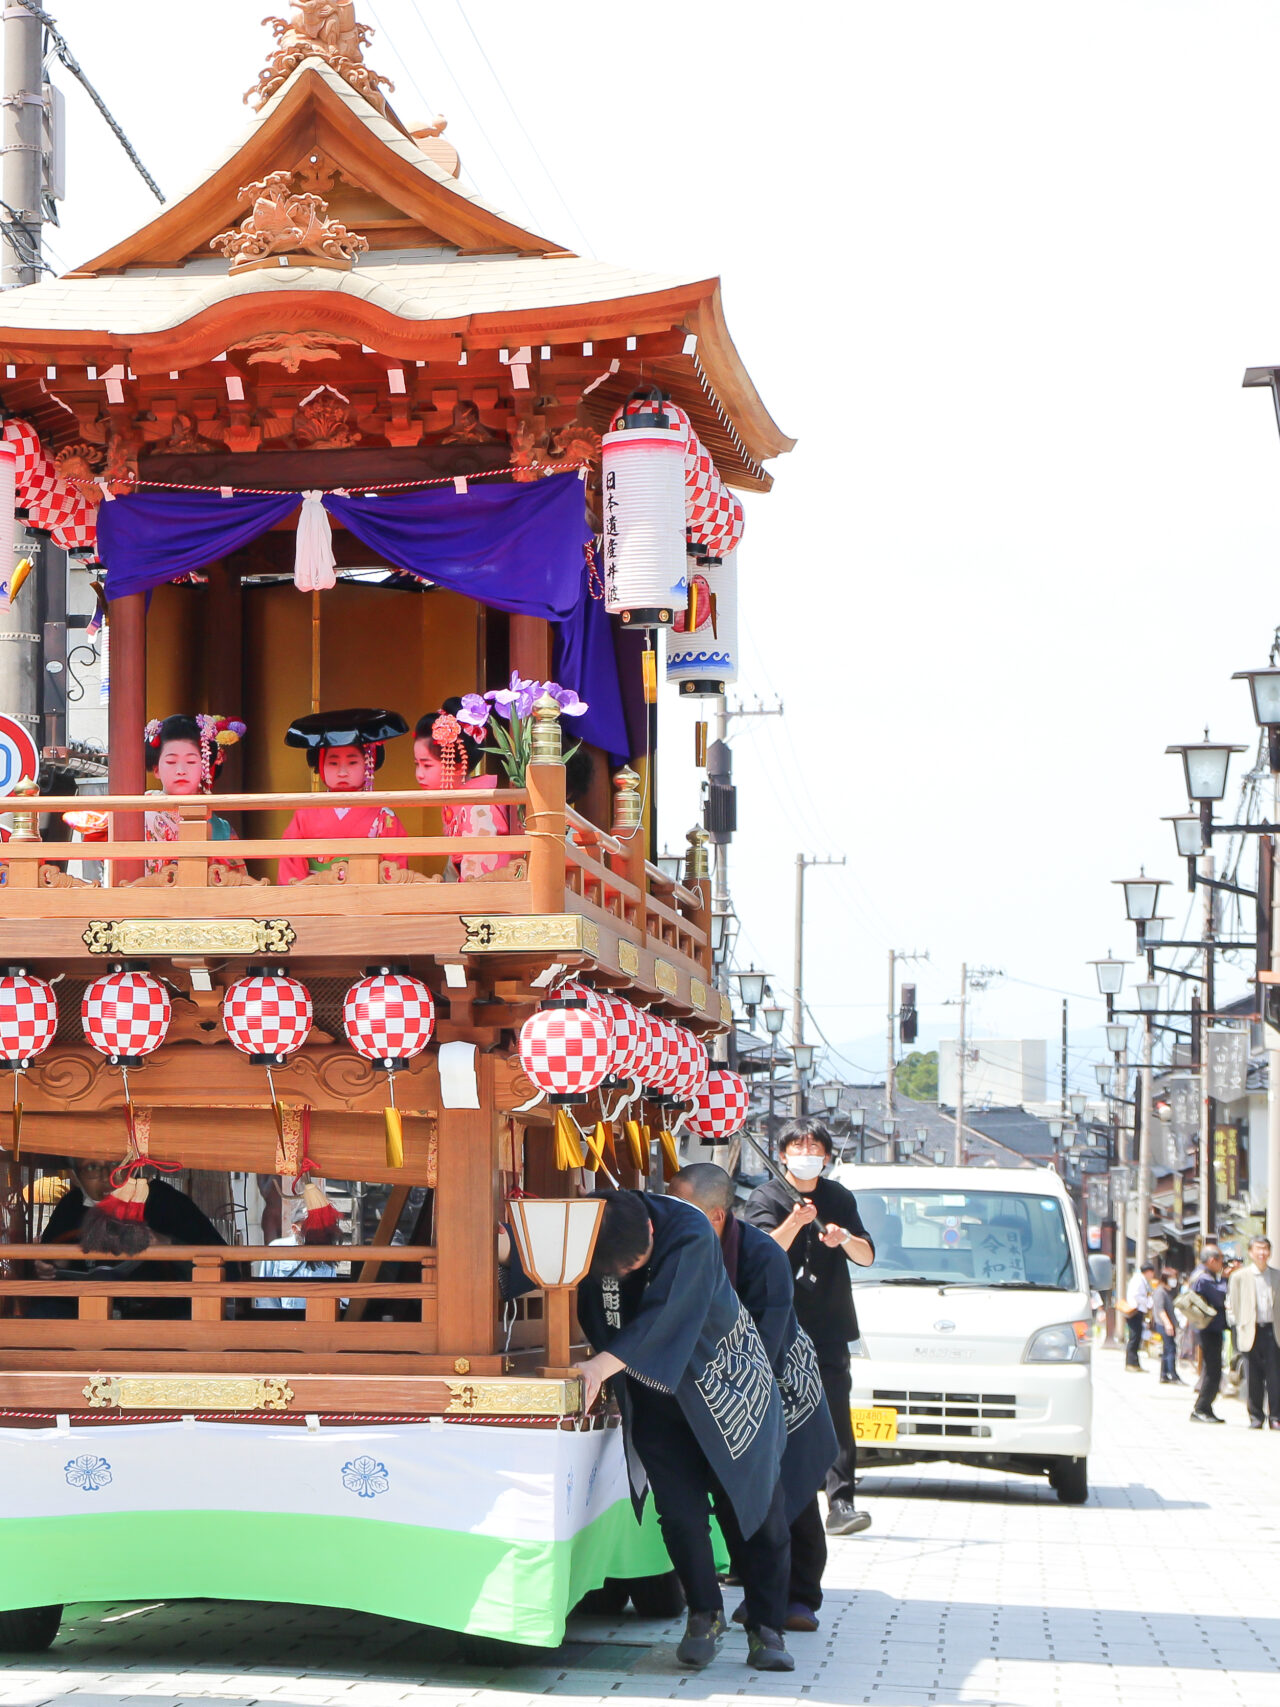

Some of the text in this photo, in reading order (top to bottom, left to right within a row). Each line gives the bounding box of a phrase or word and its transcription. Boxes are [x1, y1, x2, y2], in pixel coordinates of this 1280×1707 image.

[606, 470, 620, 604] 日本遺産井波
[981, 1233, 1006, 1278] 令和
